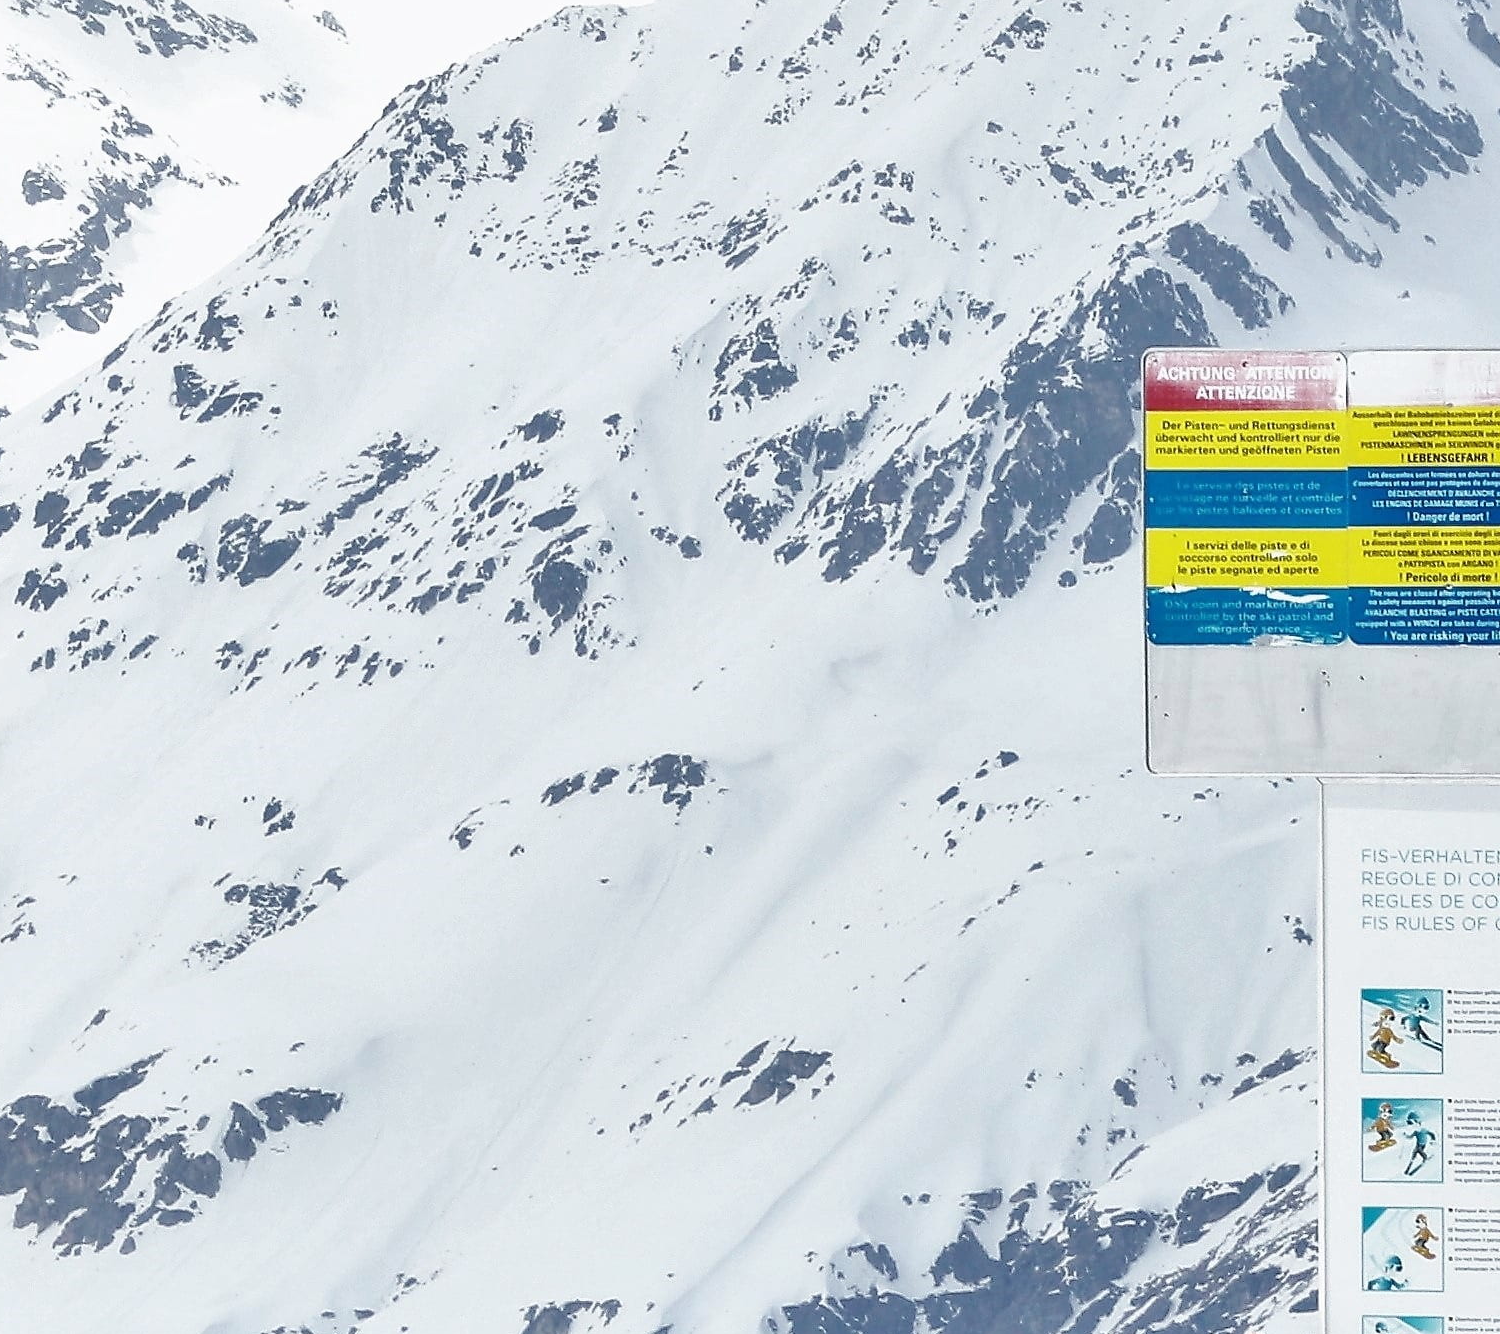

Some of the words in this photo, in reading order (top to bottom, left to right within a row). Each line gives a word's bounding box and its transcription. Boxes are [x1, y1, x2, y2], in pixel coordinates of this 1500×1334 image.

[1156, 367, 1236, 381] ACHTUNG
[1246, 366, 1334, 381] ATTENTION
[1196, 385, 1297, 400] ATTENZIONE
[1163, 421, 1181, 430] Der
[1229, 421, 1249, 430] und
[1252, 421, 1335, 431] Rettungsdienst
[1156, 433, 1214, 442] überwacht
[1217, 433, 1236, 442] und
[1240, 431, 1300, 443] kontrolliert
[1324, 433, 1340, 442] die
[1156, 445, 1216, 455] markierten
[1219, 445, 1239, 455] und
[1242, 445, 1302, 456] geöffneten
[1306, 445, 1340, 455] Pisten
[1408, 453, 1488, 463] LEBENSGEFAHR
[1413, 512, 1447, 523] Danger
[1449, 512, 1460, 521] de
[1463, 513, 1484, 521] mort
[1187, 541, 1190, 550] I
[1194, 541, 1228, 550] servizi
[1231, 541, 1257, 550] delle
[1260, 541, 1287, 552] piste
[1300, 541, 1310, 550] di
[1296, 553, 1318, 562] solo
[1178, 565, 1187, 574] le
[1191, 565, 1216, 576] piste
[1220, 567, 1264, 576] segnate
[1267, 565, 1280, 574] ed
[1284, 567, 1319, 575] aperte
[1406, 573, 1448, 582] Pericolo
[1451, 573, 1460, 582] di
[1463, 574, 1492, 582] morte
[1238, 613, 1256, 621] the
[1260, 613, 1275, 621] ski
[1278, 612, 1310, 623] patrol
[1390, 631, 1408, 641] You
[1411, 633, 1427, 641] are
[1430, 631, 1464, 642] risking
[1466, 633, 1489, 643] your
[1362, 871, 1436, 886] REGOLE
[1444, 873, 1461, 886] DI
[1362, 894, 1432, 909] REGLES
[1441, 895, 1464, 909] DE
[1362, 916, 1388, 930] FIS
[1396, 917, 1455, 931] RULES
[1462, 917, 1487, 931] OF
